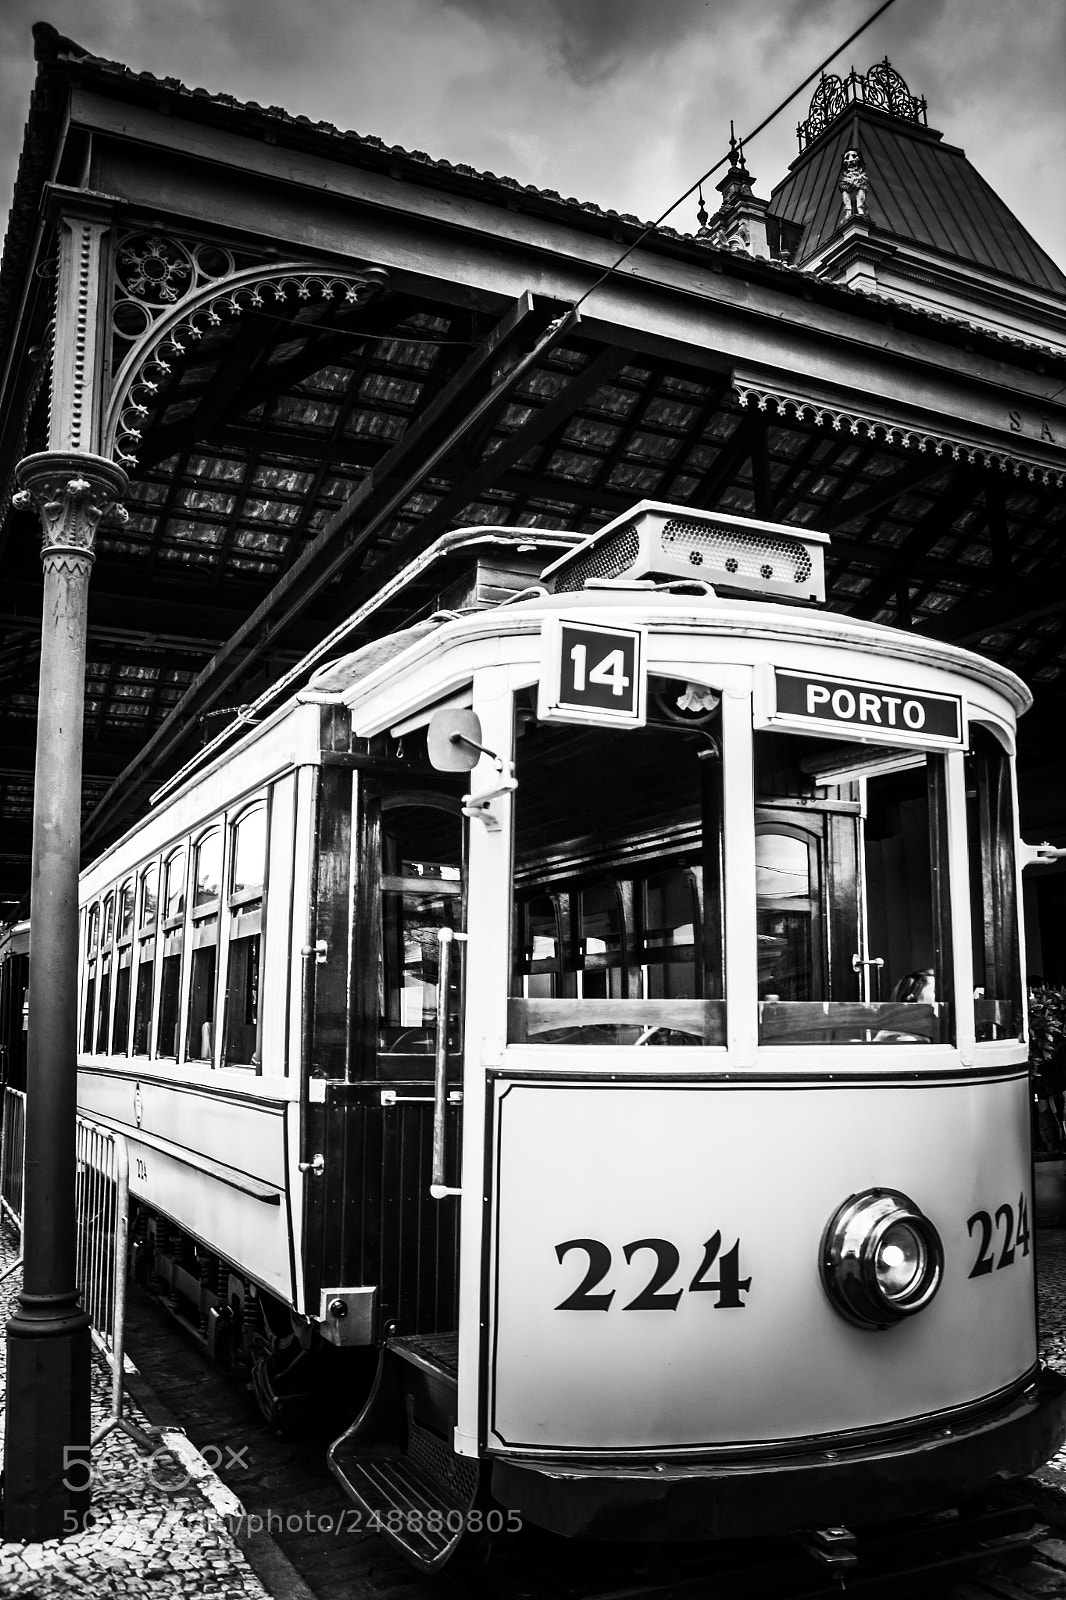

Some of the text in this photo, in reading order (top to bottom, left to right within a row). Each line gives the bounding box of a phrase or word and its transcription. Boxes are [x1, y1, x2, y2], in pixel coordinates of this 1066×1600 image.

[569, 643, 629, 696] 14
[806, 684, 926, 730] PORTO
[966, 1191, 1030, 1279] 224
[554, 1229, 752, 1312] 224
